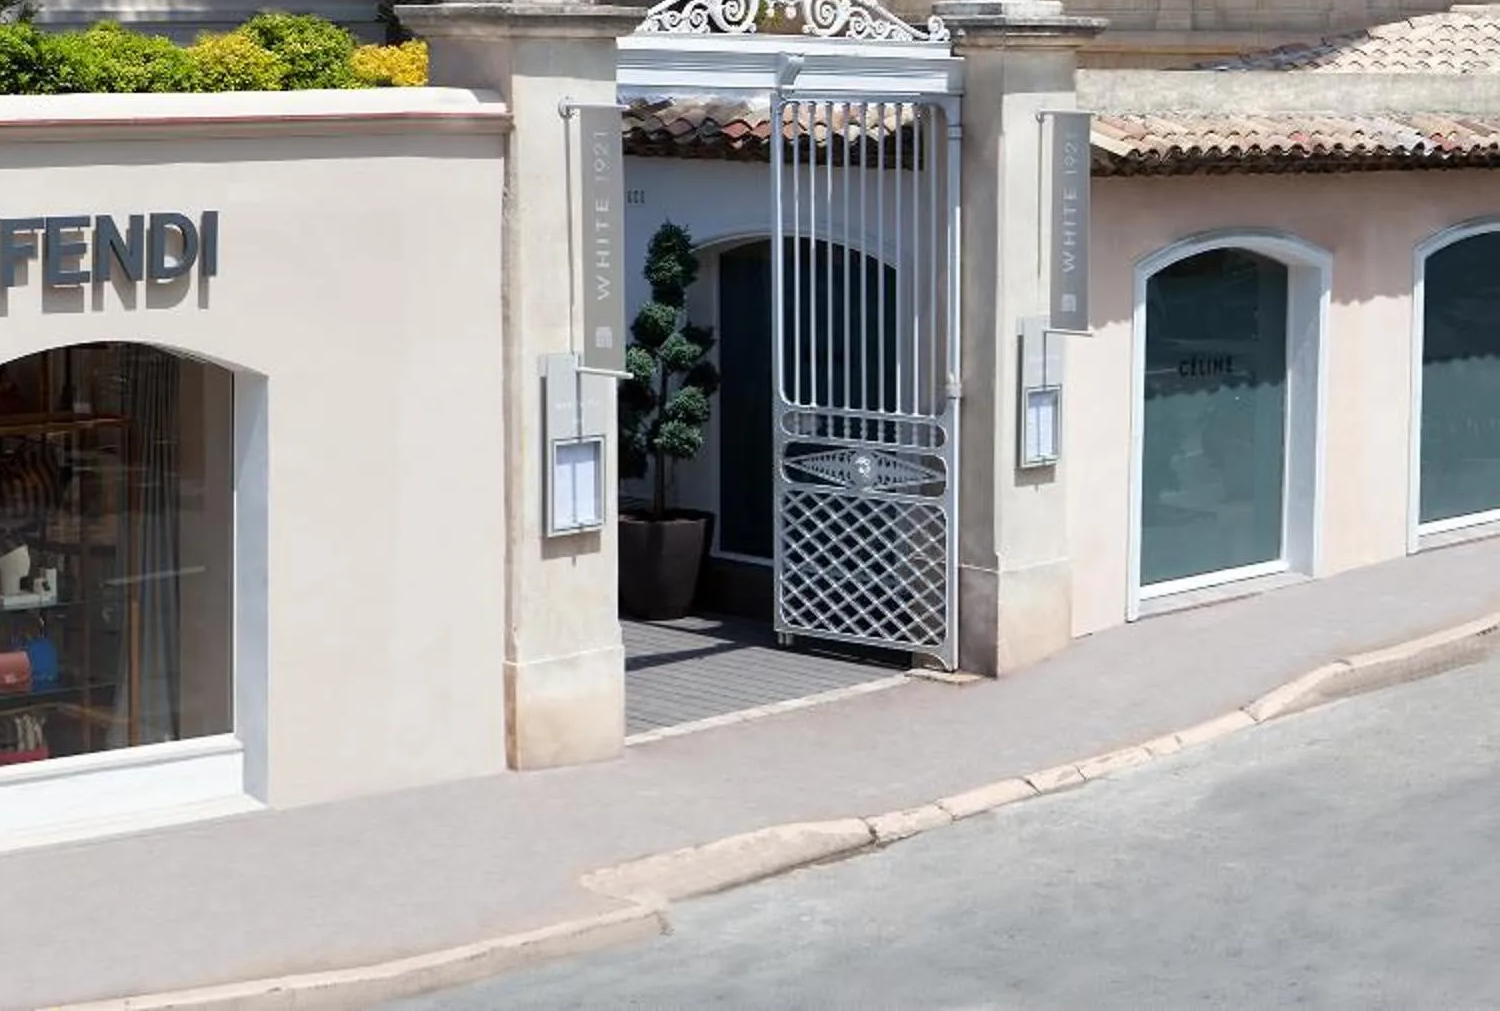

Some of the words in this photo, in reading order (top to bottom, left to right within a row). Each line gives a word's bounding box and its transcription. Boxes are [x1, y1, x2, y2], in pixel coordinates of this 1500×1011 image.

[593, 131, 611, 181] 1921
[1064, 133, 1078, 175] 1921
[595, 198, 611, 301] WHITE
[1062, 187, 1078, 273] WHITE
